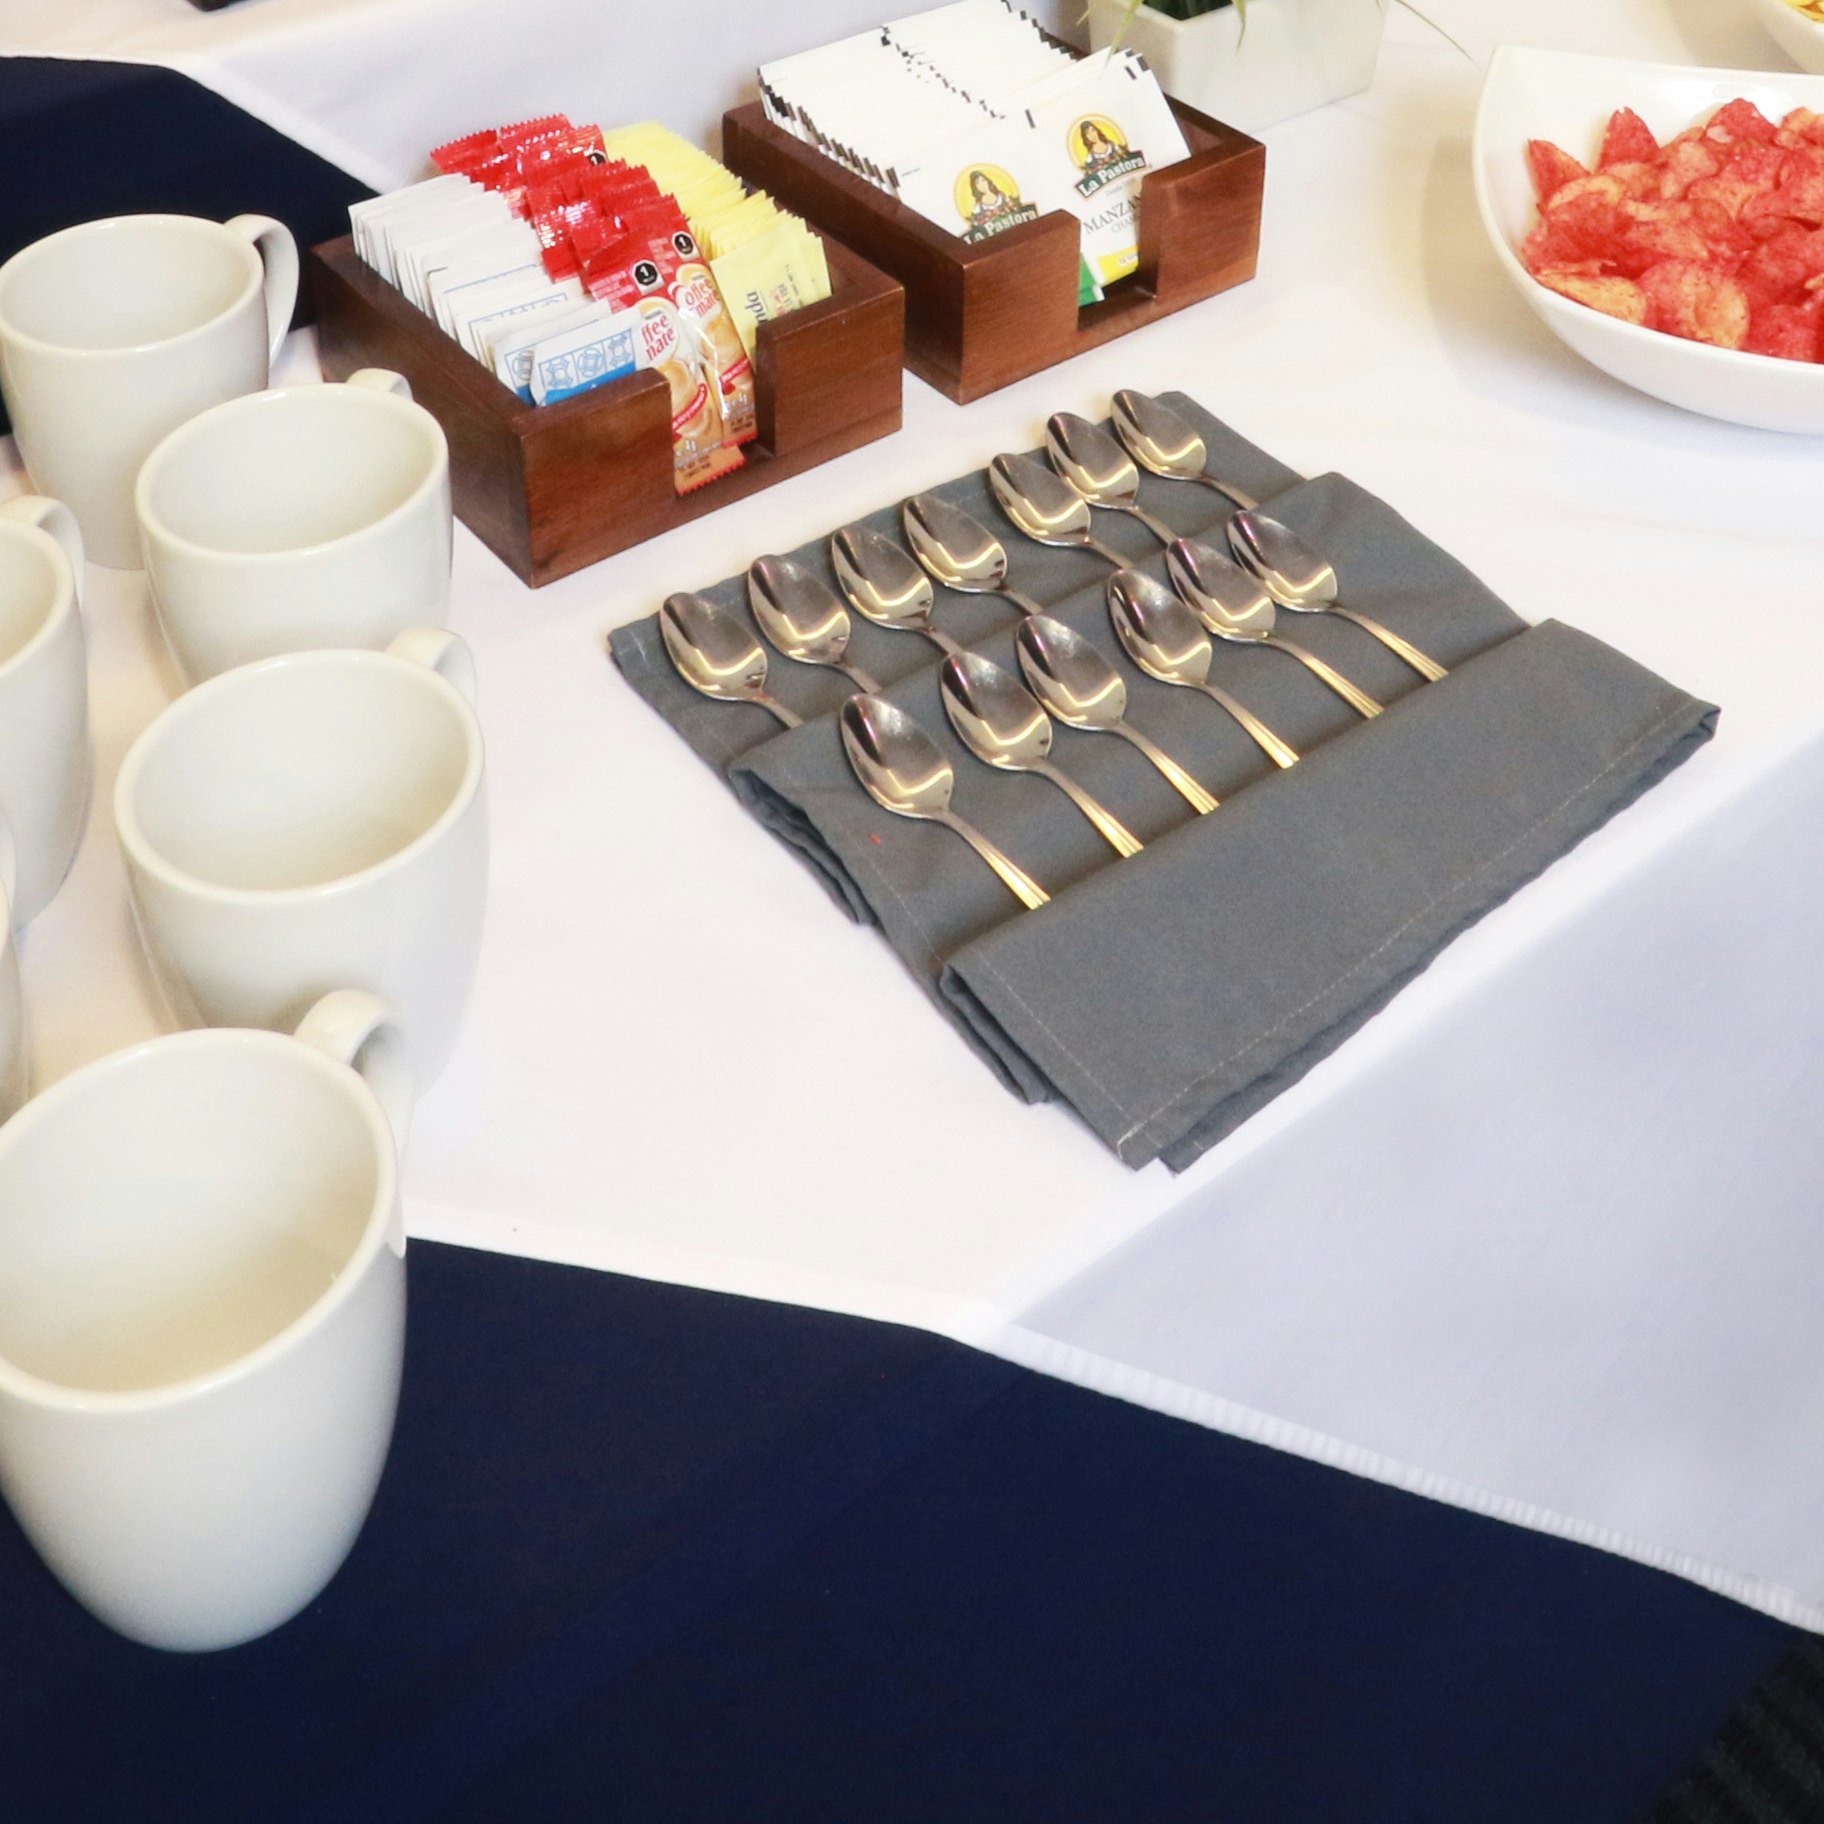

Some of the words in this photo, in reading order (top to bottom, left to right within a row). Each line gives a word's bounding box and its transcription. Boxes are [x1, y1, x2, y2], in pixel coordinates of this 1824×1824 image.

[1078, 179, 1099, 198] La
[1096, 155, 1146, 184] Pastora
[984, 208, 1037, 235] Pastora
[684, 279, 714, 307] offee
[640, 314, 668, 345] ffee
